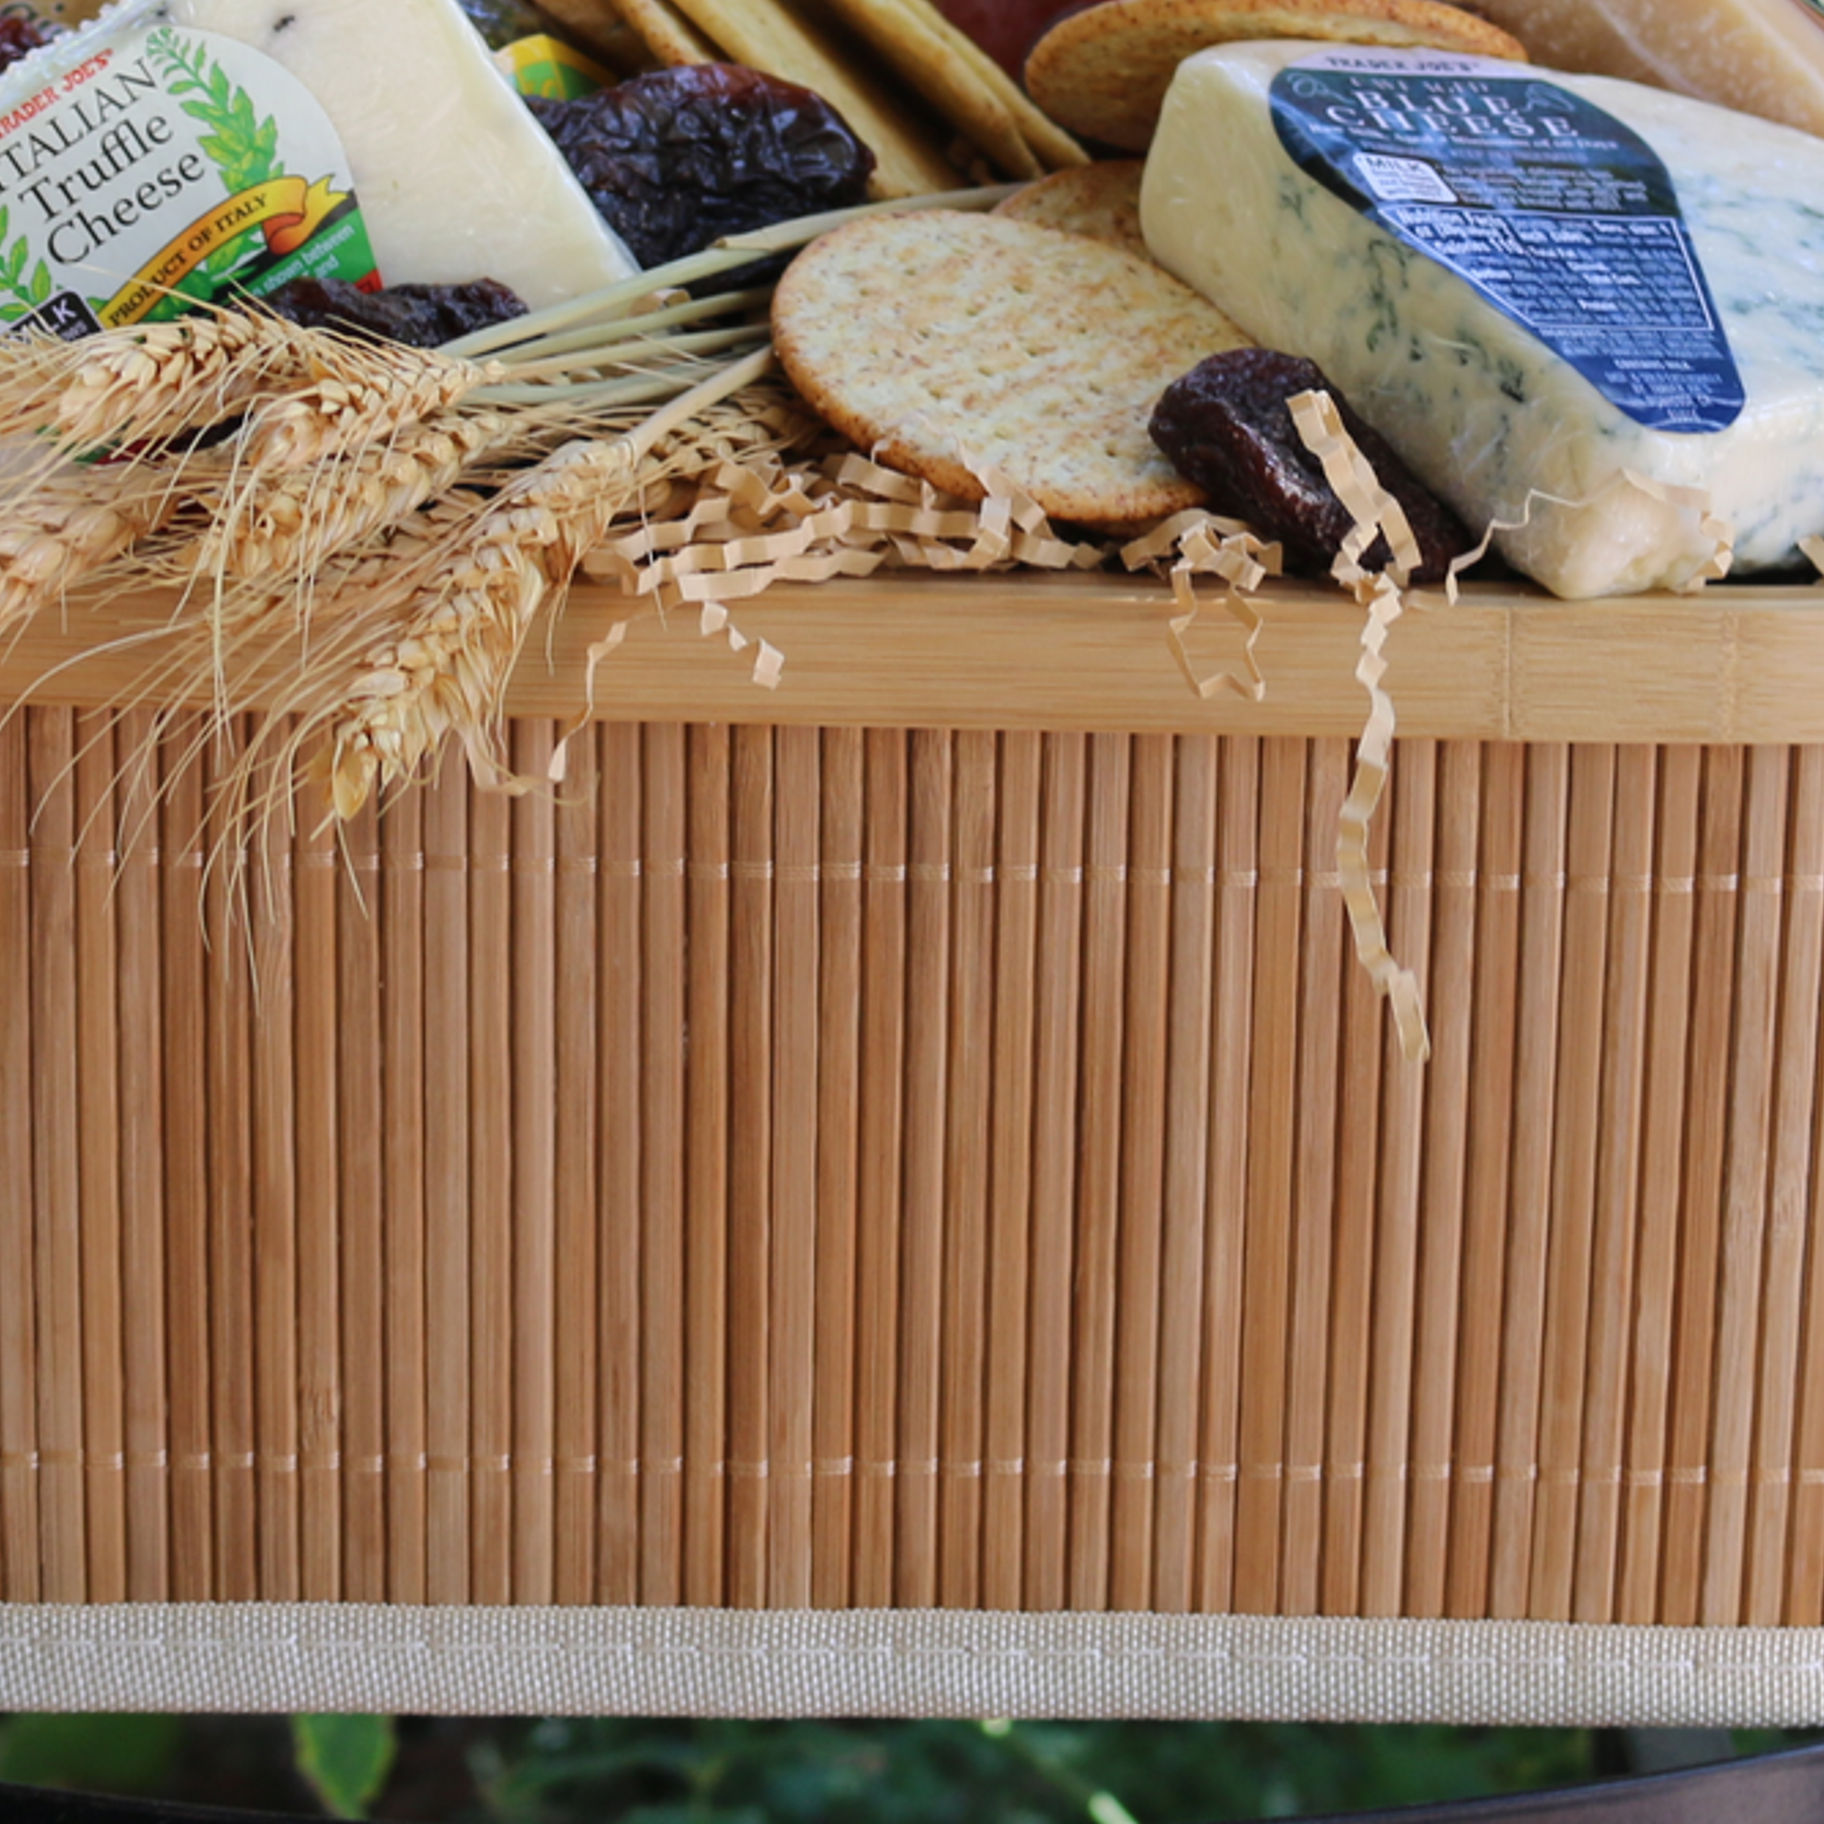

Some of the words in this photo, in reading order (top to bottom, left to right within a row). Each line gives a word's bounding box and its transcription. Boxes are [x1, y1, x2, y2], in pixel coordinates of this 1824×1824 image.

[1328, 57, 1408, 70] TRADER
[1327, 105, 1578, 137] CHEESE
[1352, 90, 1518, 115] BLUE
[18, 115, 173, 223] Truffle
[47, 152, 205, 265] Cheese
[188, 227, 214, 251] OF
[214, 192, 269, 232] ITALY
